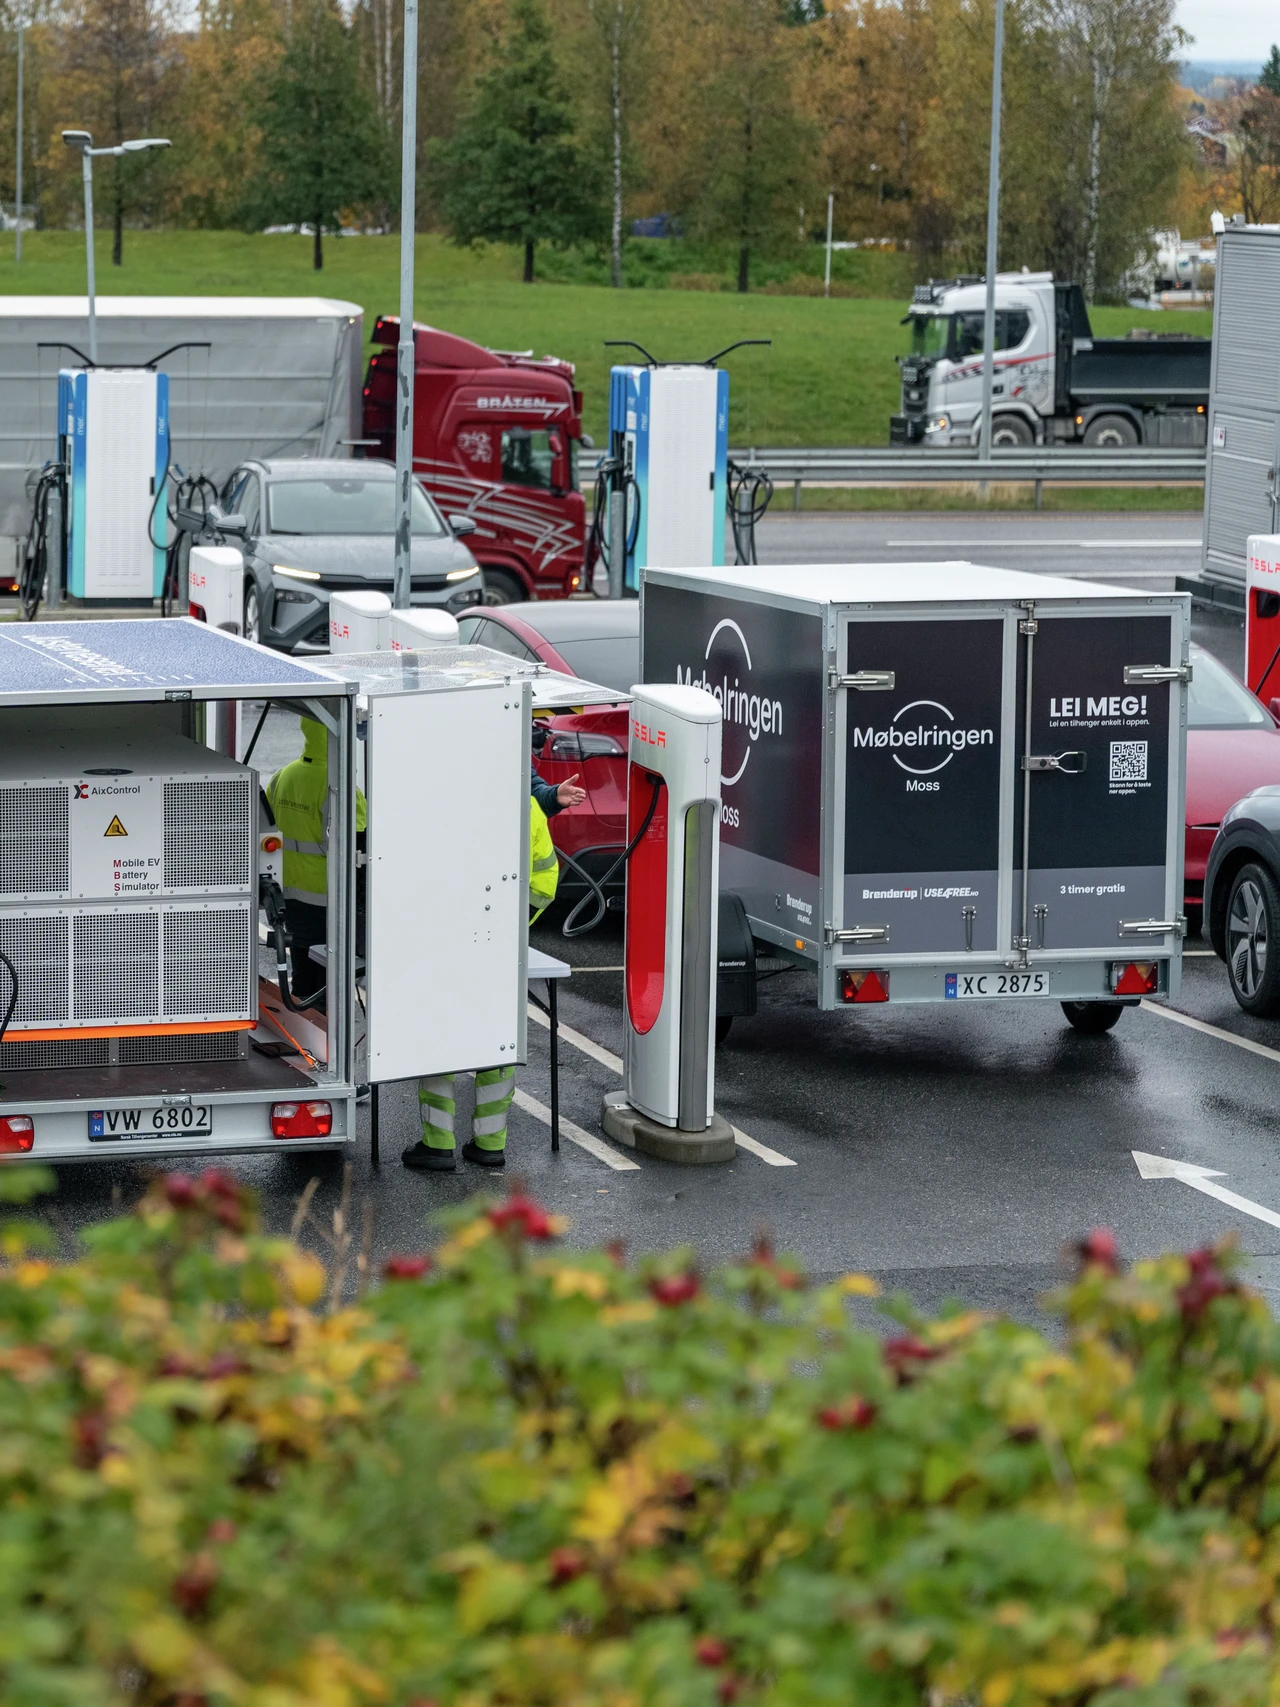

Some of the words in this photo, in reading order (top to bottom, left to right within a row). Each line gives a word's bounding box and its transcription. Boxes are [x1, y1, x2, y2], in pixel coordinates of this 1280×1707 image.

[477, 394, 547, 409] BRÅTEN
[676, 664, 783, 741] Mbelringen
[1050, 697, 1081, 717] LEI
[1086, 695, 1147, 717] MEG!
[1049, 720, 1059, 728] Lei
[1070, 719, 1100, 729] tilhenger
[1101, 718, 1121, 727] enkelt
[1126, 718, 1150, 727] appen.
[853, 725, 994, 751] Møbelringen
[91, 785, 141, 795] AixControl
[906, 779, 940, 792] Moss
[719, 798, 740, 828] oss
[113, 858, 145, 867] Mobile
[148, 858, 161, 867] EV
[114, 871, 148, 880] Battery
[114, 882, 160, 891] Simulator
[1060, 885, 1067, 894] 3
[1068, 884, 1095, 894] timer
[1096, 883, 1126, 896] gratis
[786, 893, 813, 915] Brenderup
[963, 976, 988, 995] XC
[998, 974, 1043, 994] 2875
[106, 1110, 142, 1131] VW
[152, 1106, 208, 1129] 6802
